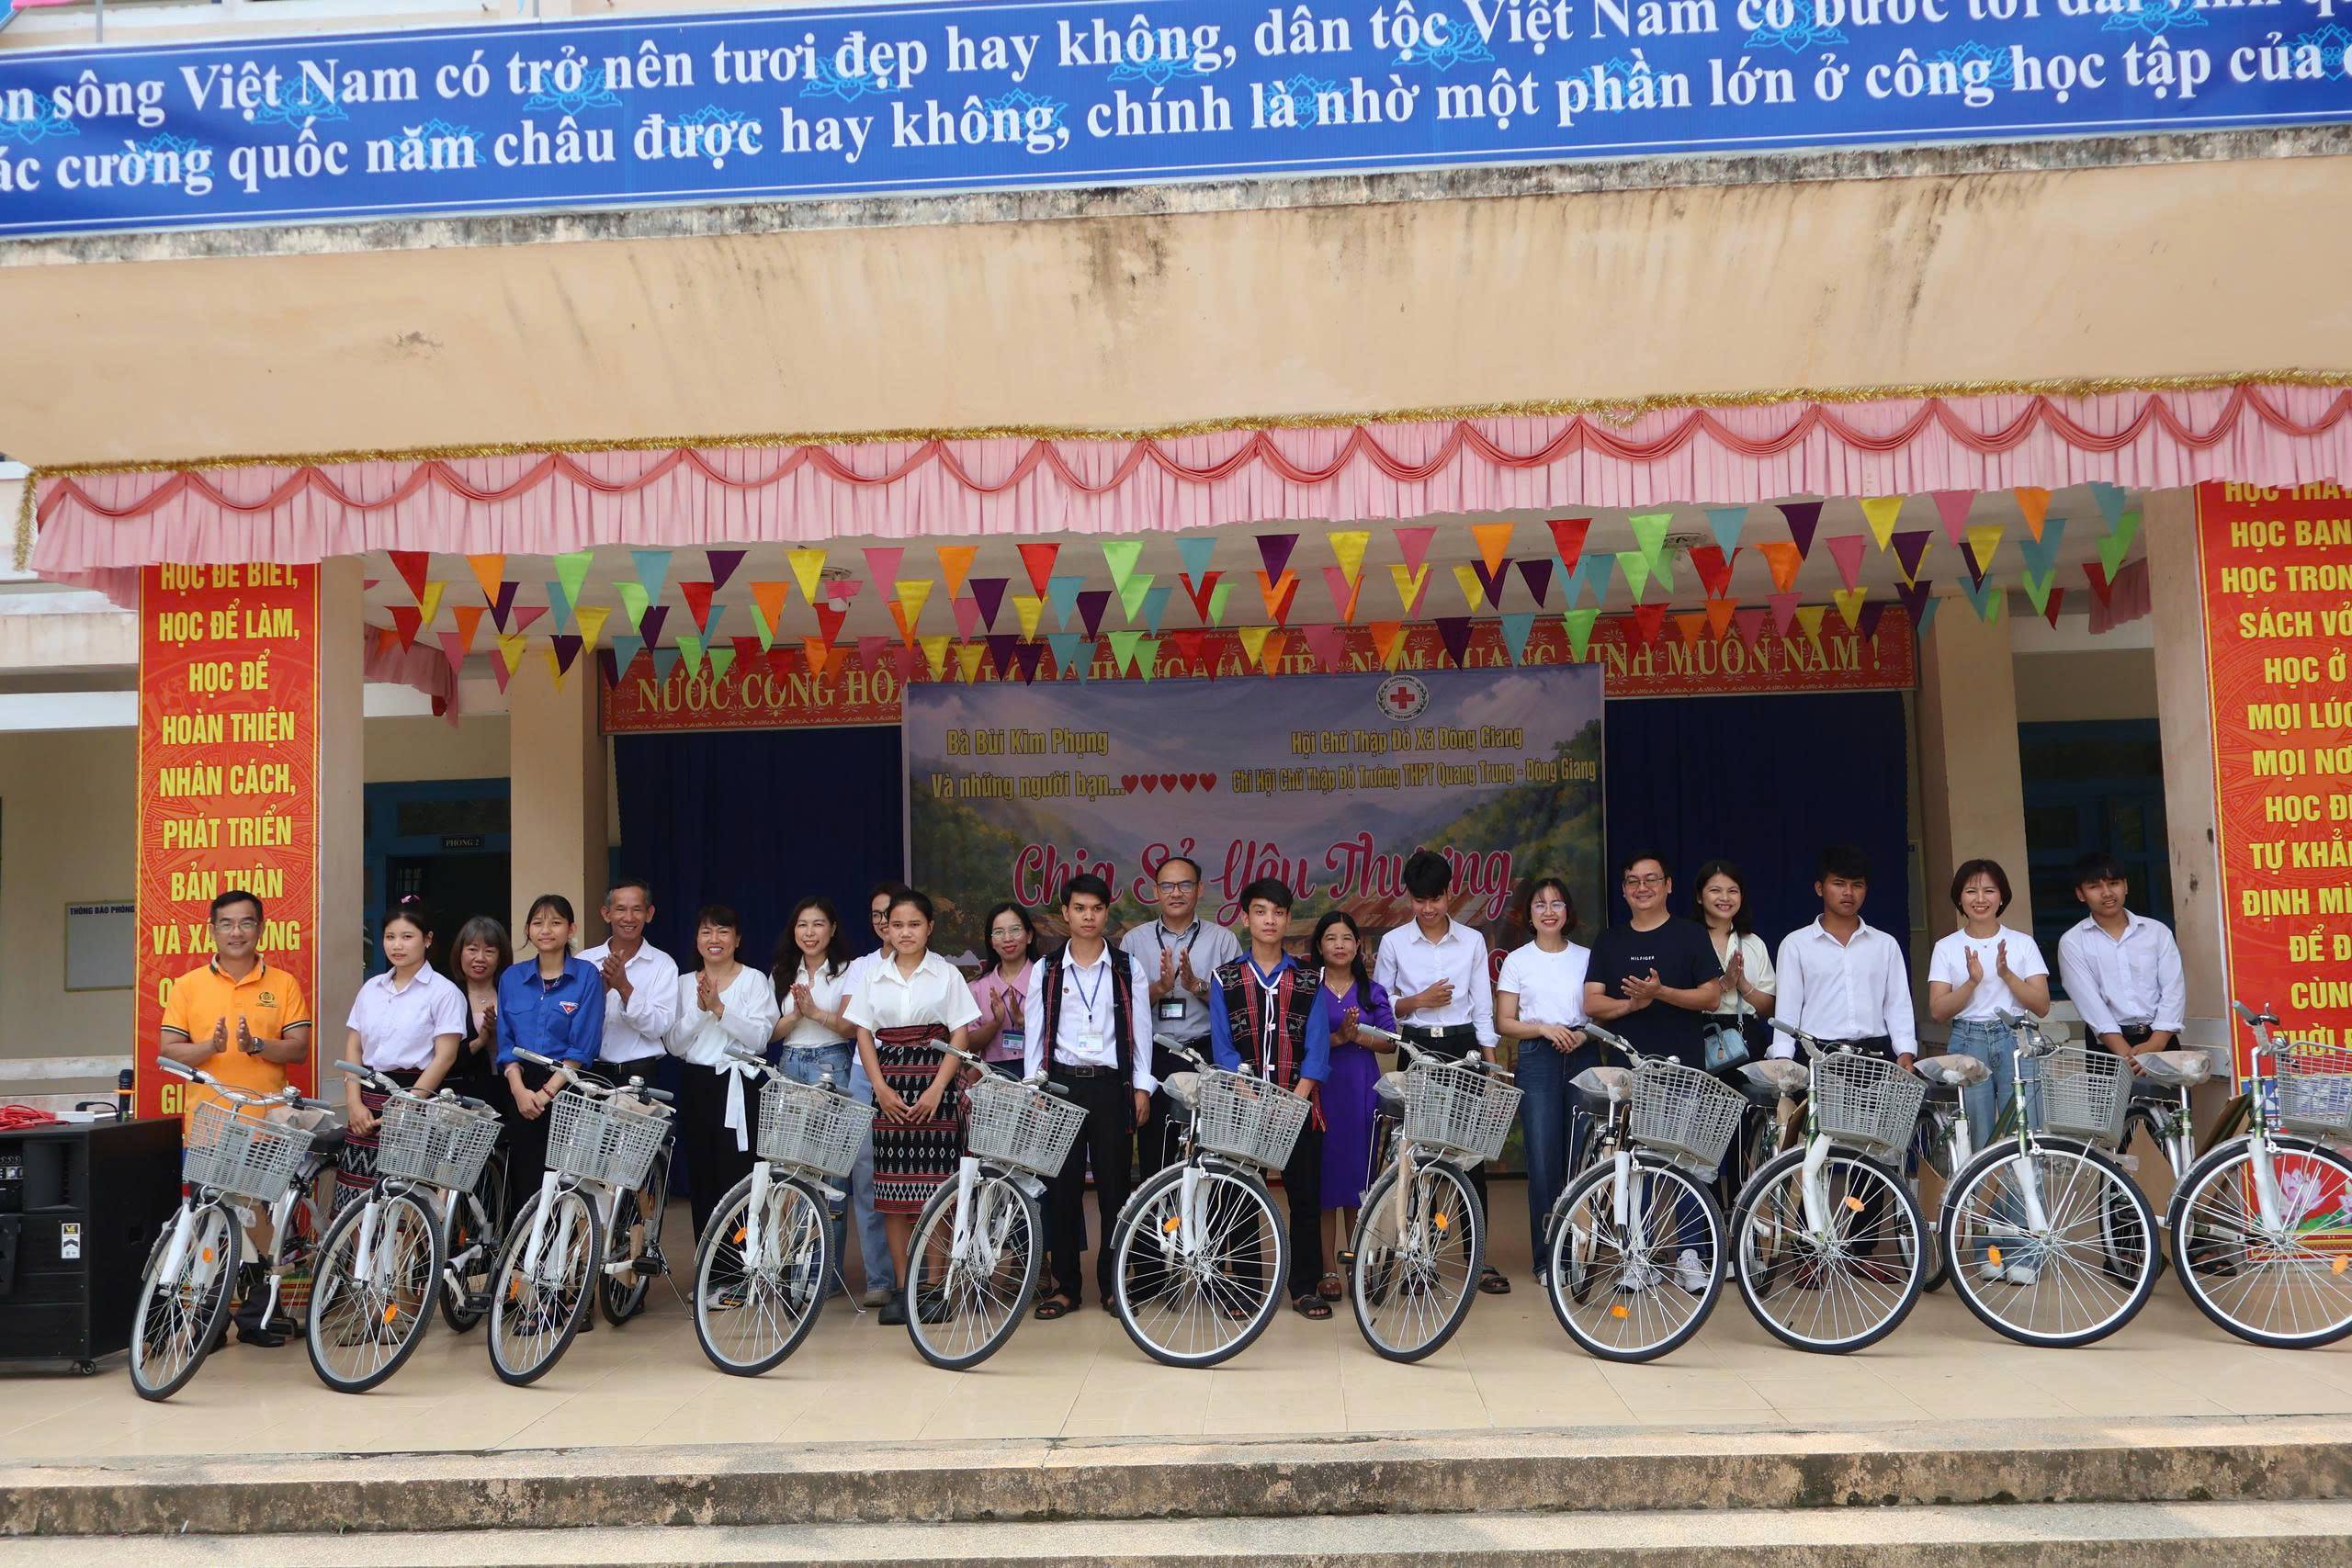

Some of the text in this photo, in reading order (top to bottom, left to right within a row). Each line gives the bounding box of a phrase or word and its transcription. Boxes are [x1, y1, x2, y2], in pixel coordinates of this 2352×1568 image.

[52, 70, 165, 127] sông
[179, 61, 282, 121] Việt
[299, 59, 418, 105] Nam
[435, 50, 490, 98] có
[506, 45, 588, 95] trở
[603, 39, 694, 89] nên
[711, 33, 817, 84] tươi
[835, 31, 927, 89] đẹp
[945, 26, 1040, 82] hay
[1057, 14, 1237, 72] không,
[1254, 6, 1351, 56] dân
[1371, 0, 1449, 62] tộc
[1464, 0, 1574, 55] Việt
[1590, 0, 1719, 39] Nam
[57, 140, 213, 195] cường
[229, 116, 348, 193] quốc
[366, 126, 477, 174] năm
[494, 116, 616, 166] châu
[634, 113, 763, 170] được
[780, 107, 874, 164] hay
[890, 96, 1070, 153] không,
[1087, 85, 1233, 138] chính
[1250, 76, 1298, 130] là
[1316, 74, 1420, 126] nhờ
[1435, 68, 1540, 130] một
[1555, 48, 1690, 128] phần
[1709, 56, 1796, 107] lớn
[1815, 52, 1849, 101] ở
[1866, 49, 1996, 107] công
[2009, 44, 2107, 102] học
[2122, 35, 2211, 98] tập
[2230, 31, 2324, 83] của
[2224, 481, 2278, 507] HỌC
[2231, 519, 2352, 553] HỌC BẠN
[162, 562, 206, 596] HỌC
[2222, 567, 2278, 599] HỌC
[159, 598, 300, 648] HỌC ĐỂ LÀM,
[2239, 601, 2352, 638] SÁCH VỞ
[189, 649, 270, 698] HỌC ĐỂ
[845, 658, 903, 706] HÒ
[2264, 647, 2346, 689] HỌC Ở
[162, 705, 295, 749] HOÀN THIỆN
[2247, 703, 2301, 736] MỌI
[946, 728, 1110, 760] Bà Bùi Kim Phụng
[1291, 724, 1524, 760] Hội Chữ Thập Đỏ Xã Đông Giang
[159, 758, 296, 797] NHÂN CÁCH,
[1402, 762, 1435, 787] THPT
[1436, 761, 1477, 788] Quang
[1477, 760, 1515, 785] Trung
[1524, 757, 1558, 784] Đông
[1560, 757, 1597, 783] Giang
[2252, 749, 2306, 782] MỌI
[931, 772, 955, 799] Và
[959, 771, 1014, 802] những
[1019, 770, 1070, 801] người
[163, 804, 292, 850] PHÁT TRIỂN
[2265, 795, 2321, 828] HỌC
[2248, 828, 2352, 874] TỰ KHẲ
[171, 861, 283, 902] BẢN THÂN
[1324, 830, 1513, 920] Thưng
[2242, 888, 2311, 922] ĐỊNH
[153, 918, 181, 955] VÀ
[2289, 923, 2326, 963] ĐỂ
[2290, 976, 2352, 1010] CÙN
